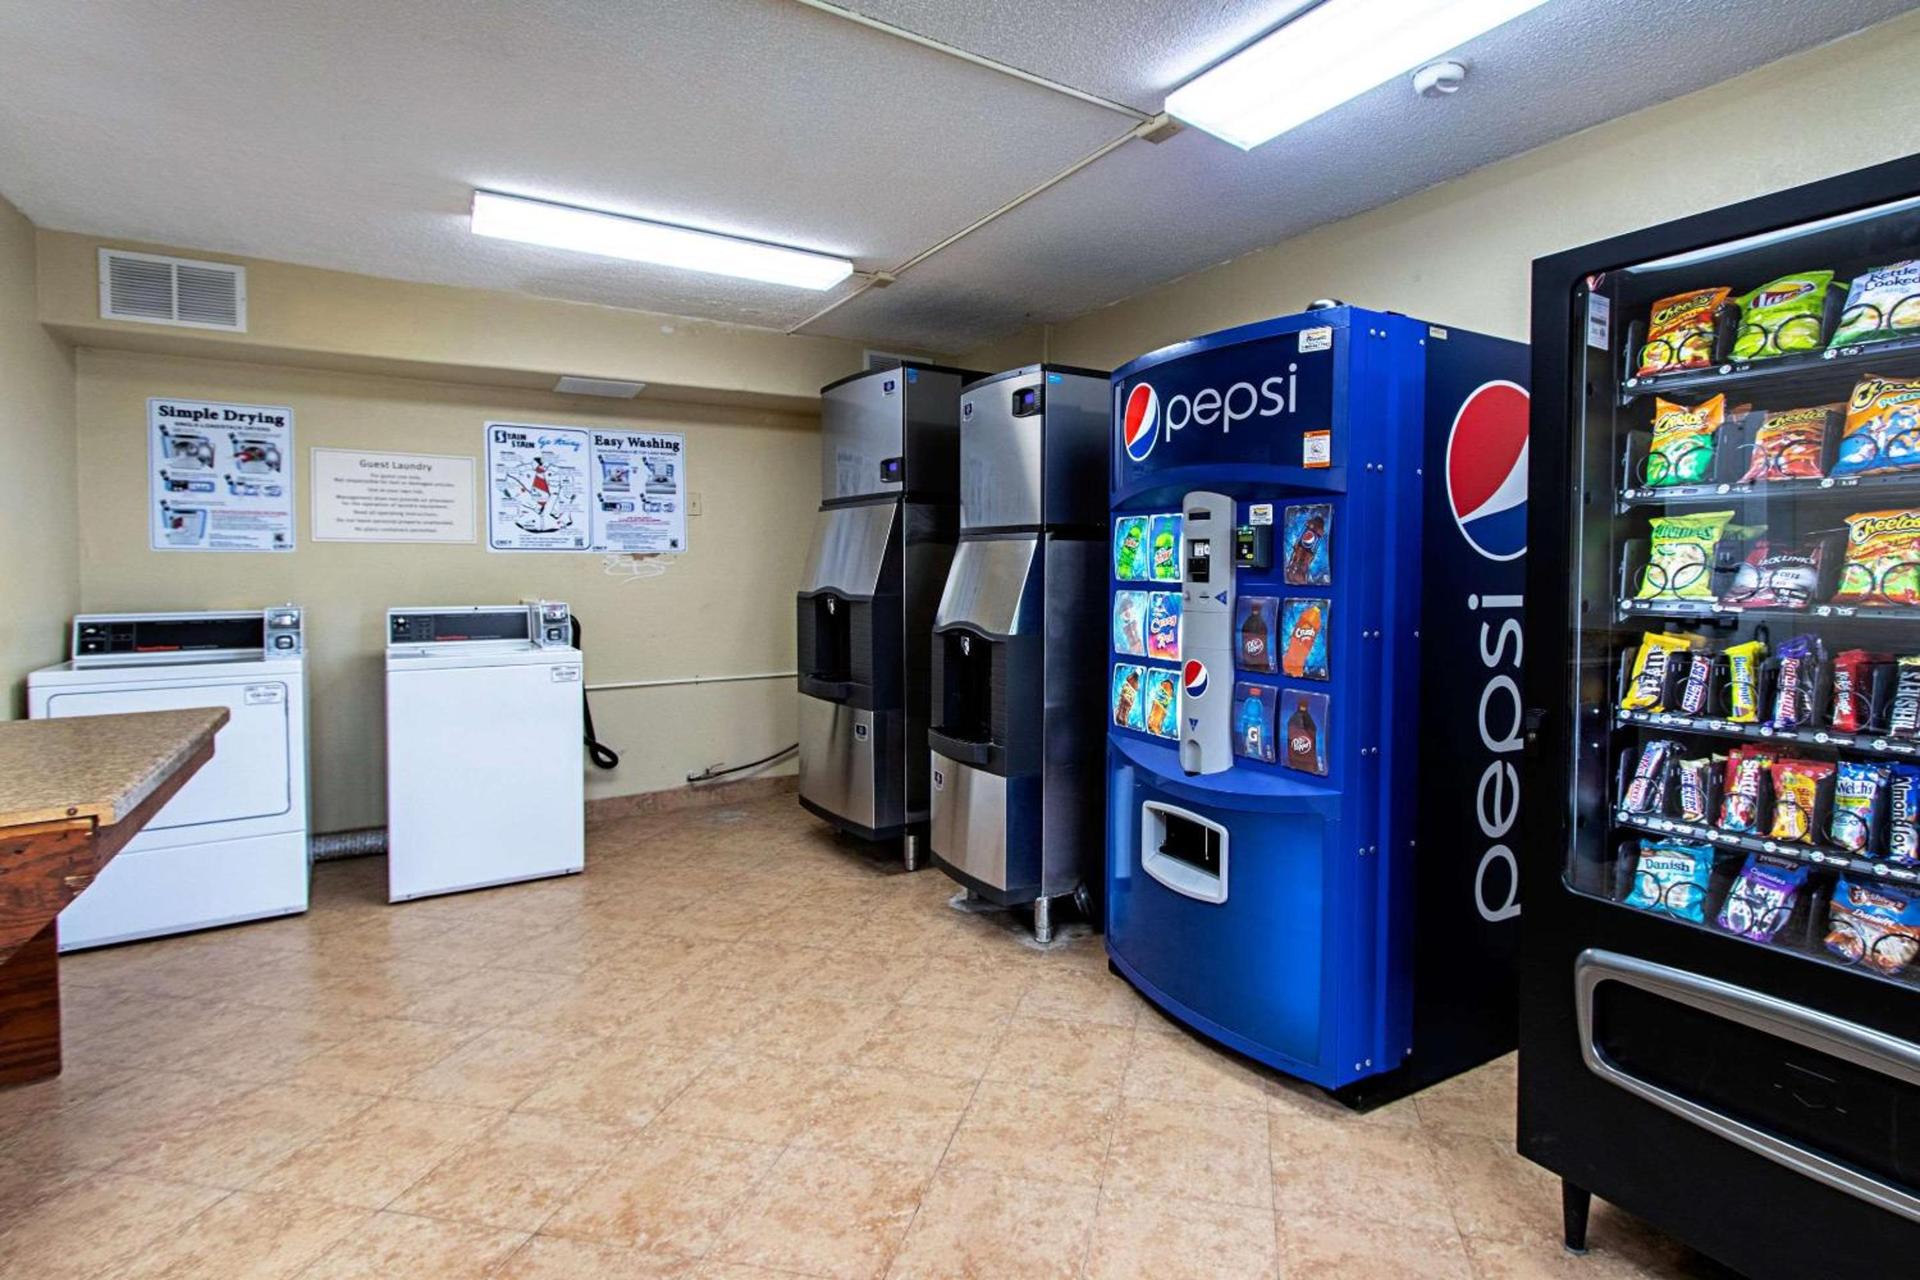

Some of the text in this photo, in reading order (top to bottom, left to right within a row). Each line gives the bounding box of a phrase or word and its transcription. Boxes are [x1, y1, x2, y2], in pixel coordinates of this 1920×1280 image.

[1165, 362, 1298, 443] pepsi
[158, 405, 219, 421] Simple
[223, 409, 285, 428] Drying
[511, 440, 535, 449] STAIN
[594, 434, 623, 449] Easy
[626, 436, 680, 452] Washing
[359, 459, 432, 472] Guest Laundry
[1247, 726, 1258, 742] G
[1468, 594, 1524, 923] pepsi
[1645, 857, 1691, 873] Danish
